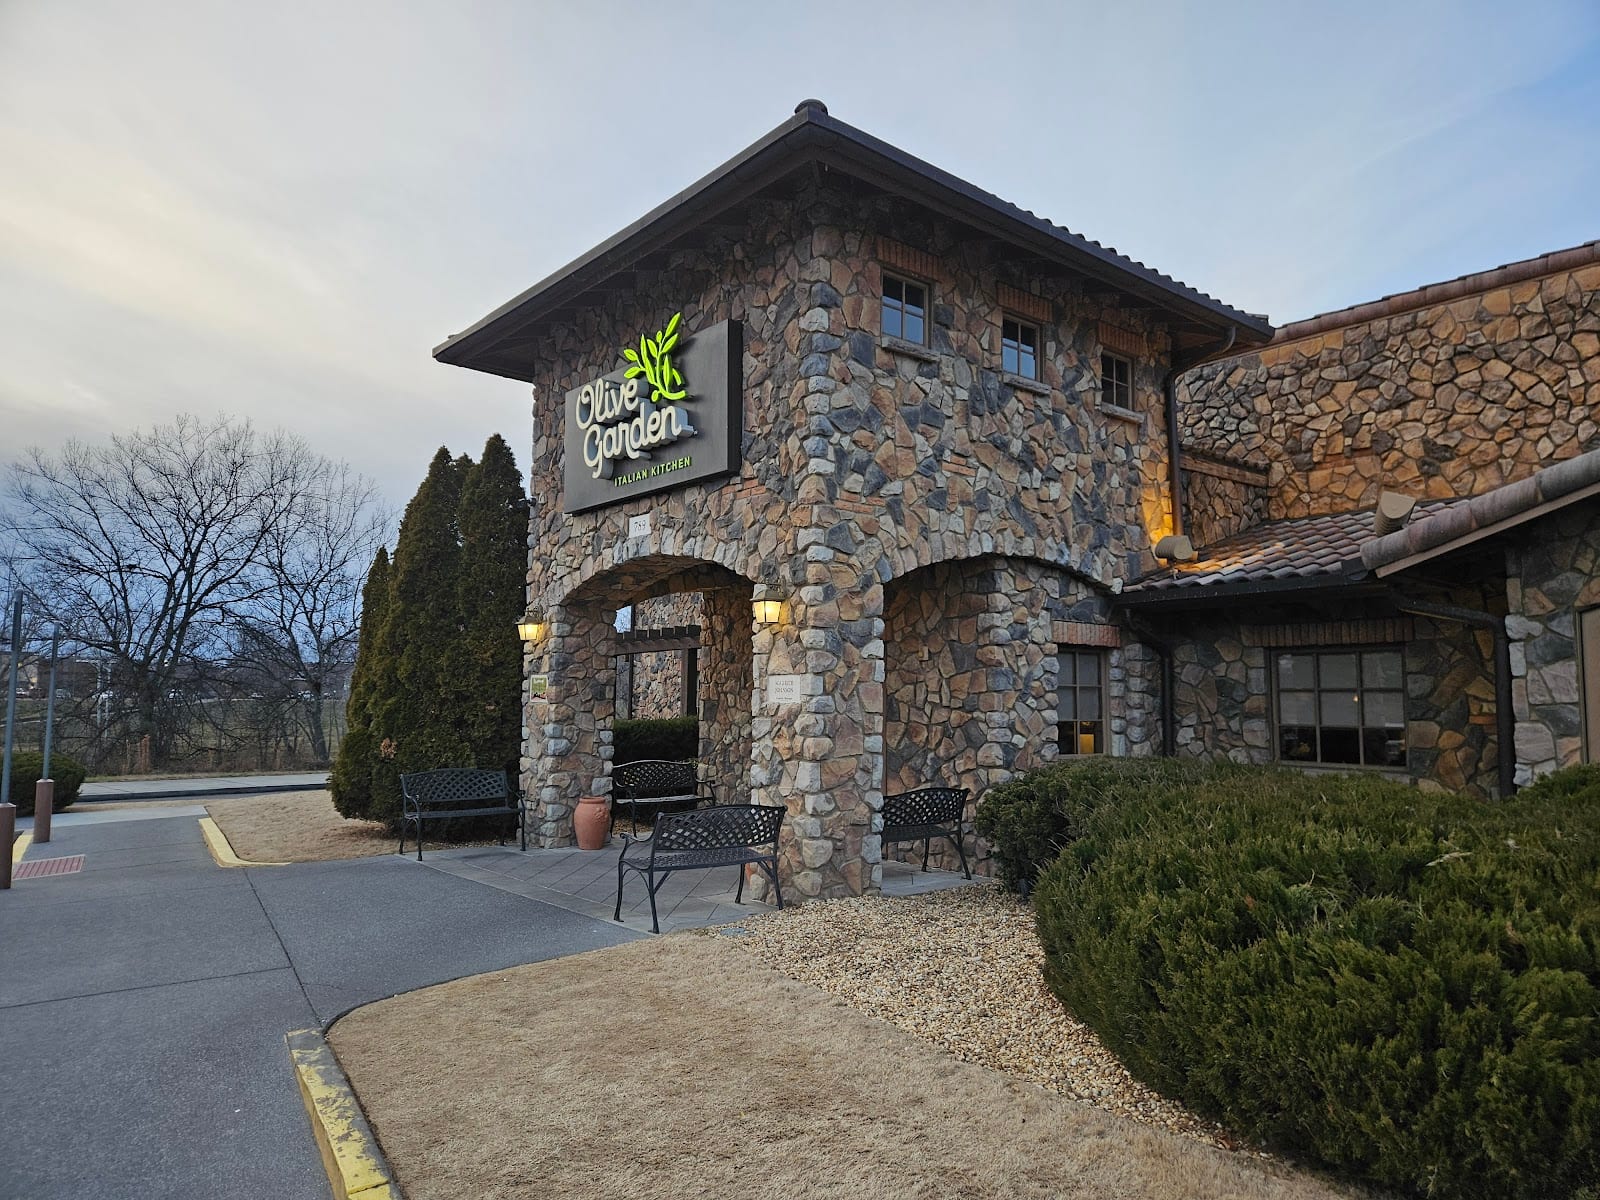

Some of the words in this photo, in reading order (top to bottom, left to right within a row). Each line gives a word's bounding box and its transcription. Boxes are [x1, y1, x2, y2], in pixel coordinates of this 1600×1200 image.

[575, 377, 640, 430] Olive
[583, 401, 683, 479] Garden
[614, 468, 649, 487] ITALIAN
[651, 455, 692, 477] KITCHEN
